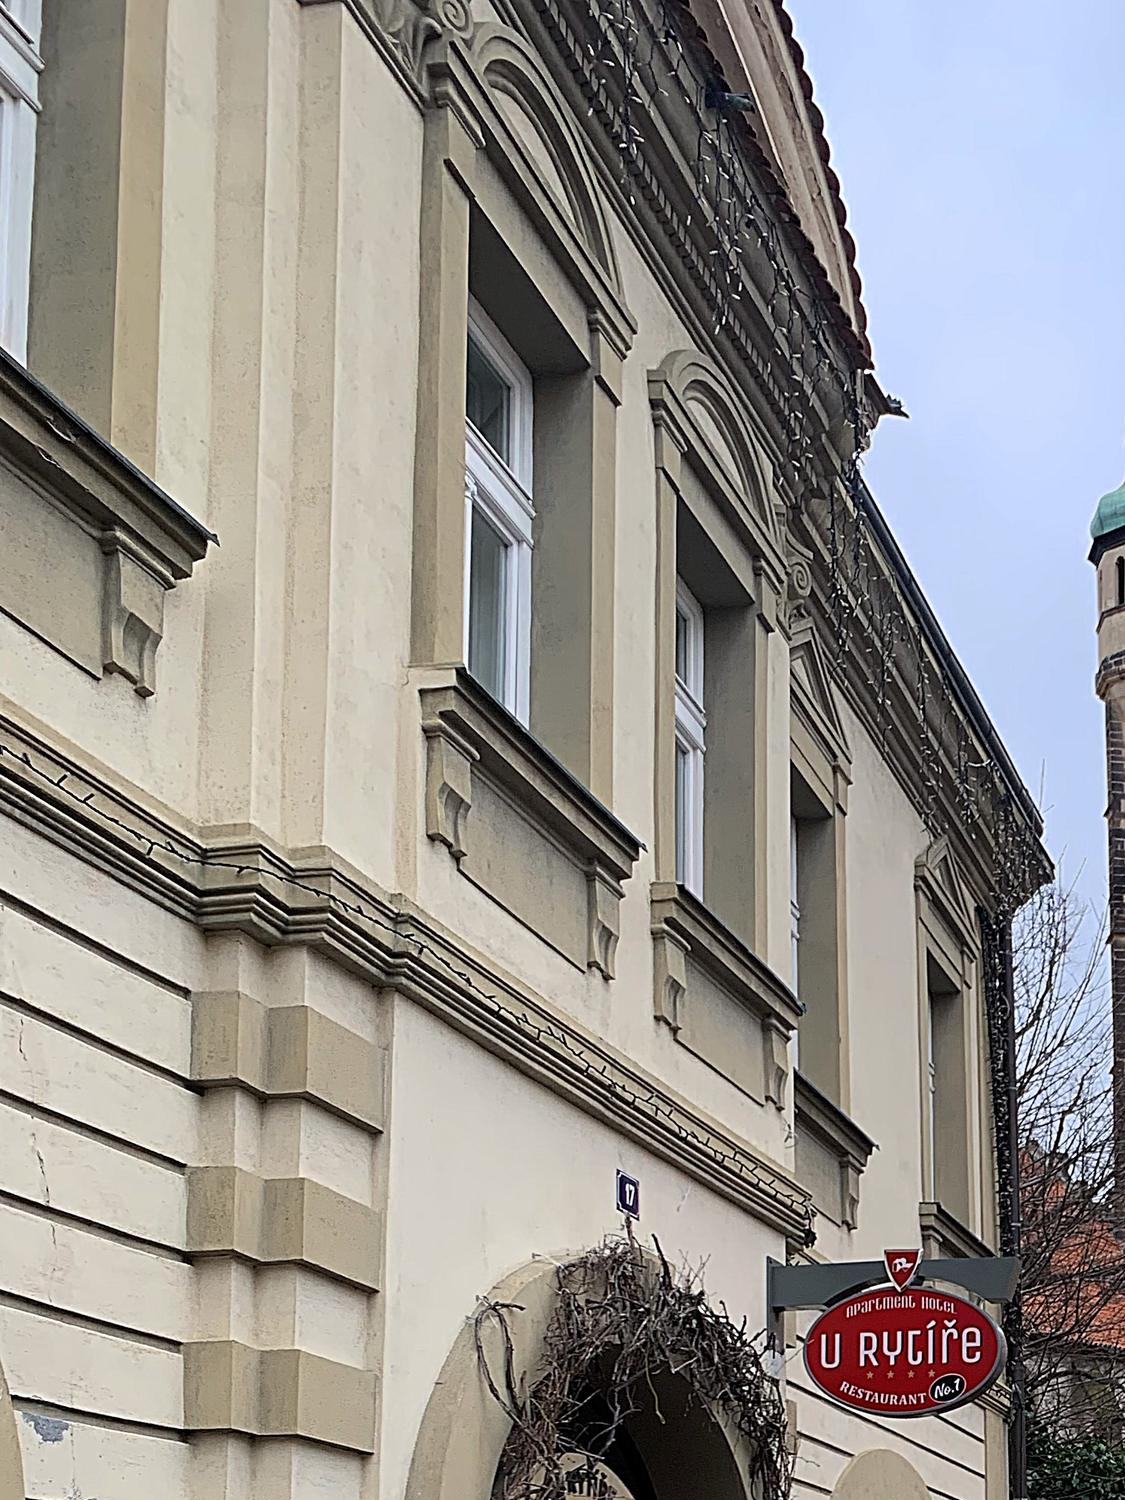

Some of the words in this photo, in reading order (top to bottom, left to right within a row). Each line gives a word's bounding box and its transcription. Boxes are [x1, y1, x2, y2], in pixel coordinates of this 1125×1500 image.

[625, 1183, 635, 1206] 17
[820, 1332, 841, 1369] U
[839, 1380, 927, 1405] RESTAURANT
[934, 1378, 961, 1399] No.1
